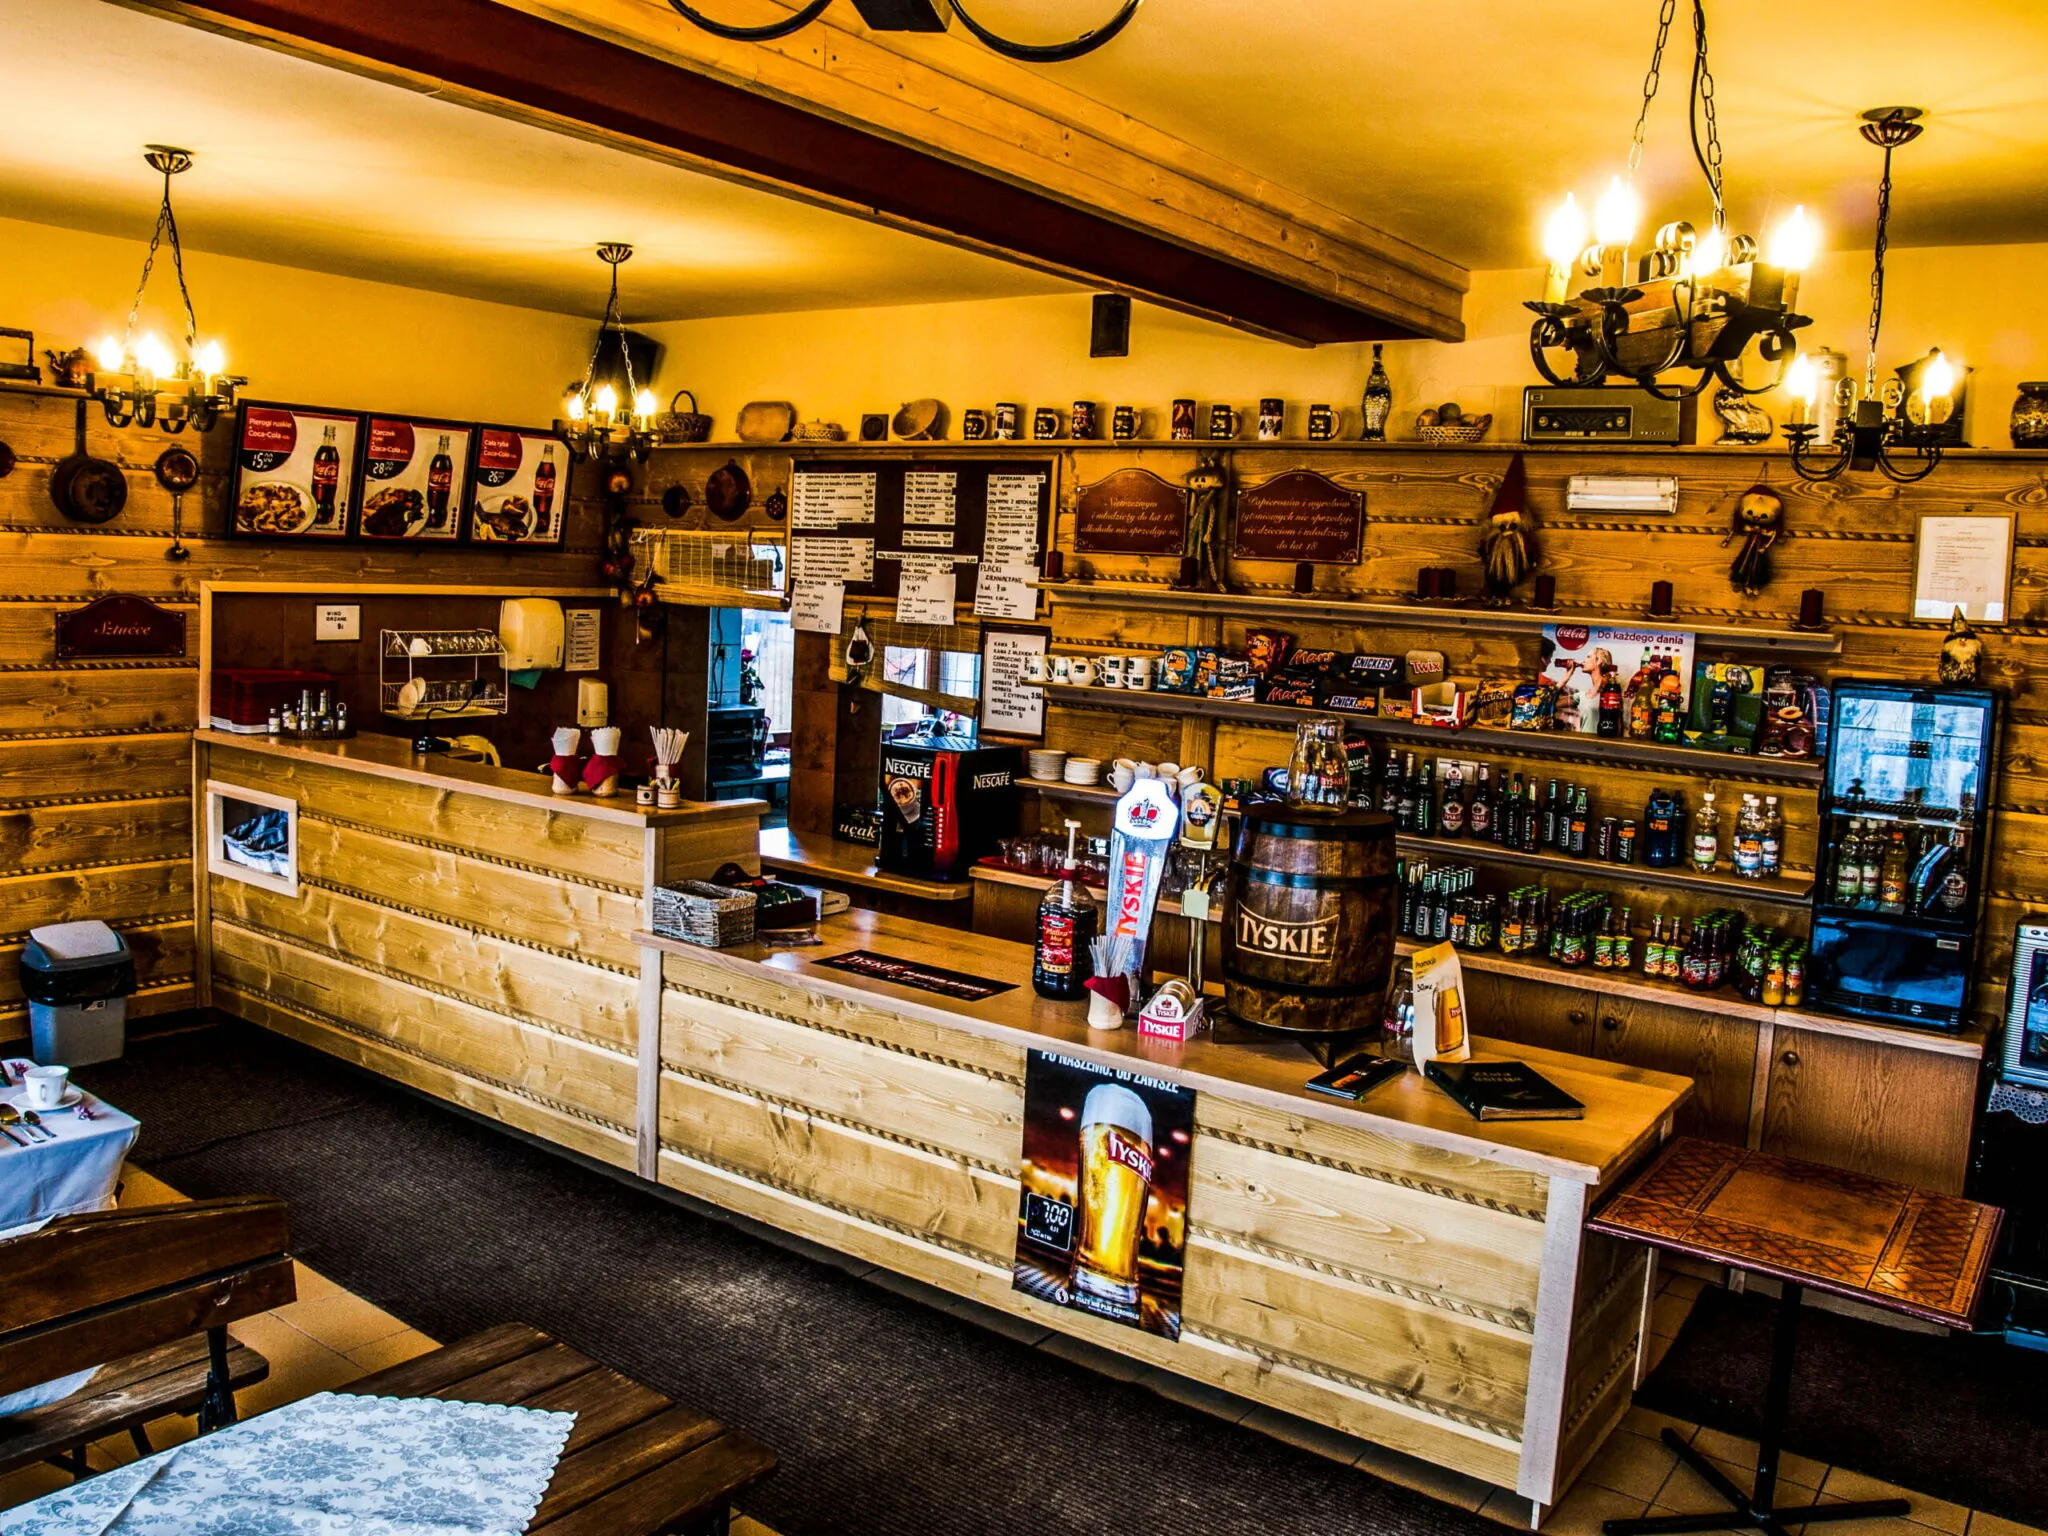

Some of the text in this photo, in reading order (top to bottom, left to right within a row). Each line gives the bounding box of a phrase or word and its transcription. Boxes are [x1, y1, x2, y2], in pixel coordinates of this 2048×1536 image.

[1597, 629, 1612, 640] Do
[1613, 629, 1655, 645] każdego
[1289, 648, 1336, 666] Mars
[1353, 656, 1394, 671] SNICKERS
[1409, 659, 1442, 675] Twix
[885, 756, 932, 780] NESCAFÉ
[973, 771, 1011, 791] NESCAFÉ
[1113, 852, 1148, 938] TYSKIE
[1240, 912, 1328, 955] TYSKIE
[1468, 923, 1478, 947] FRUGO
[848, 955, 904, 973] TYSKIE
[1157, 1009, 1176, 1018] TYSKIE
[1143, 1019, 1181, 1038] TYSKIE
